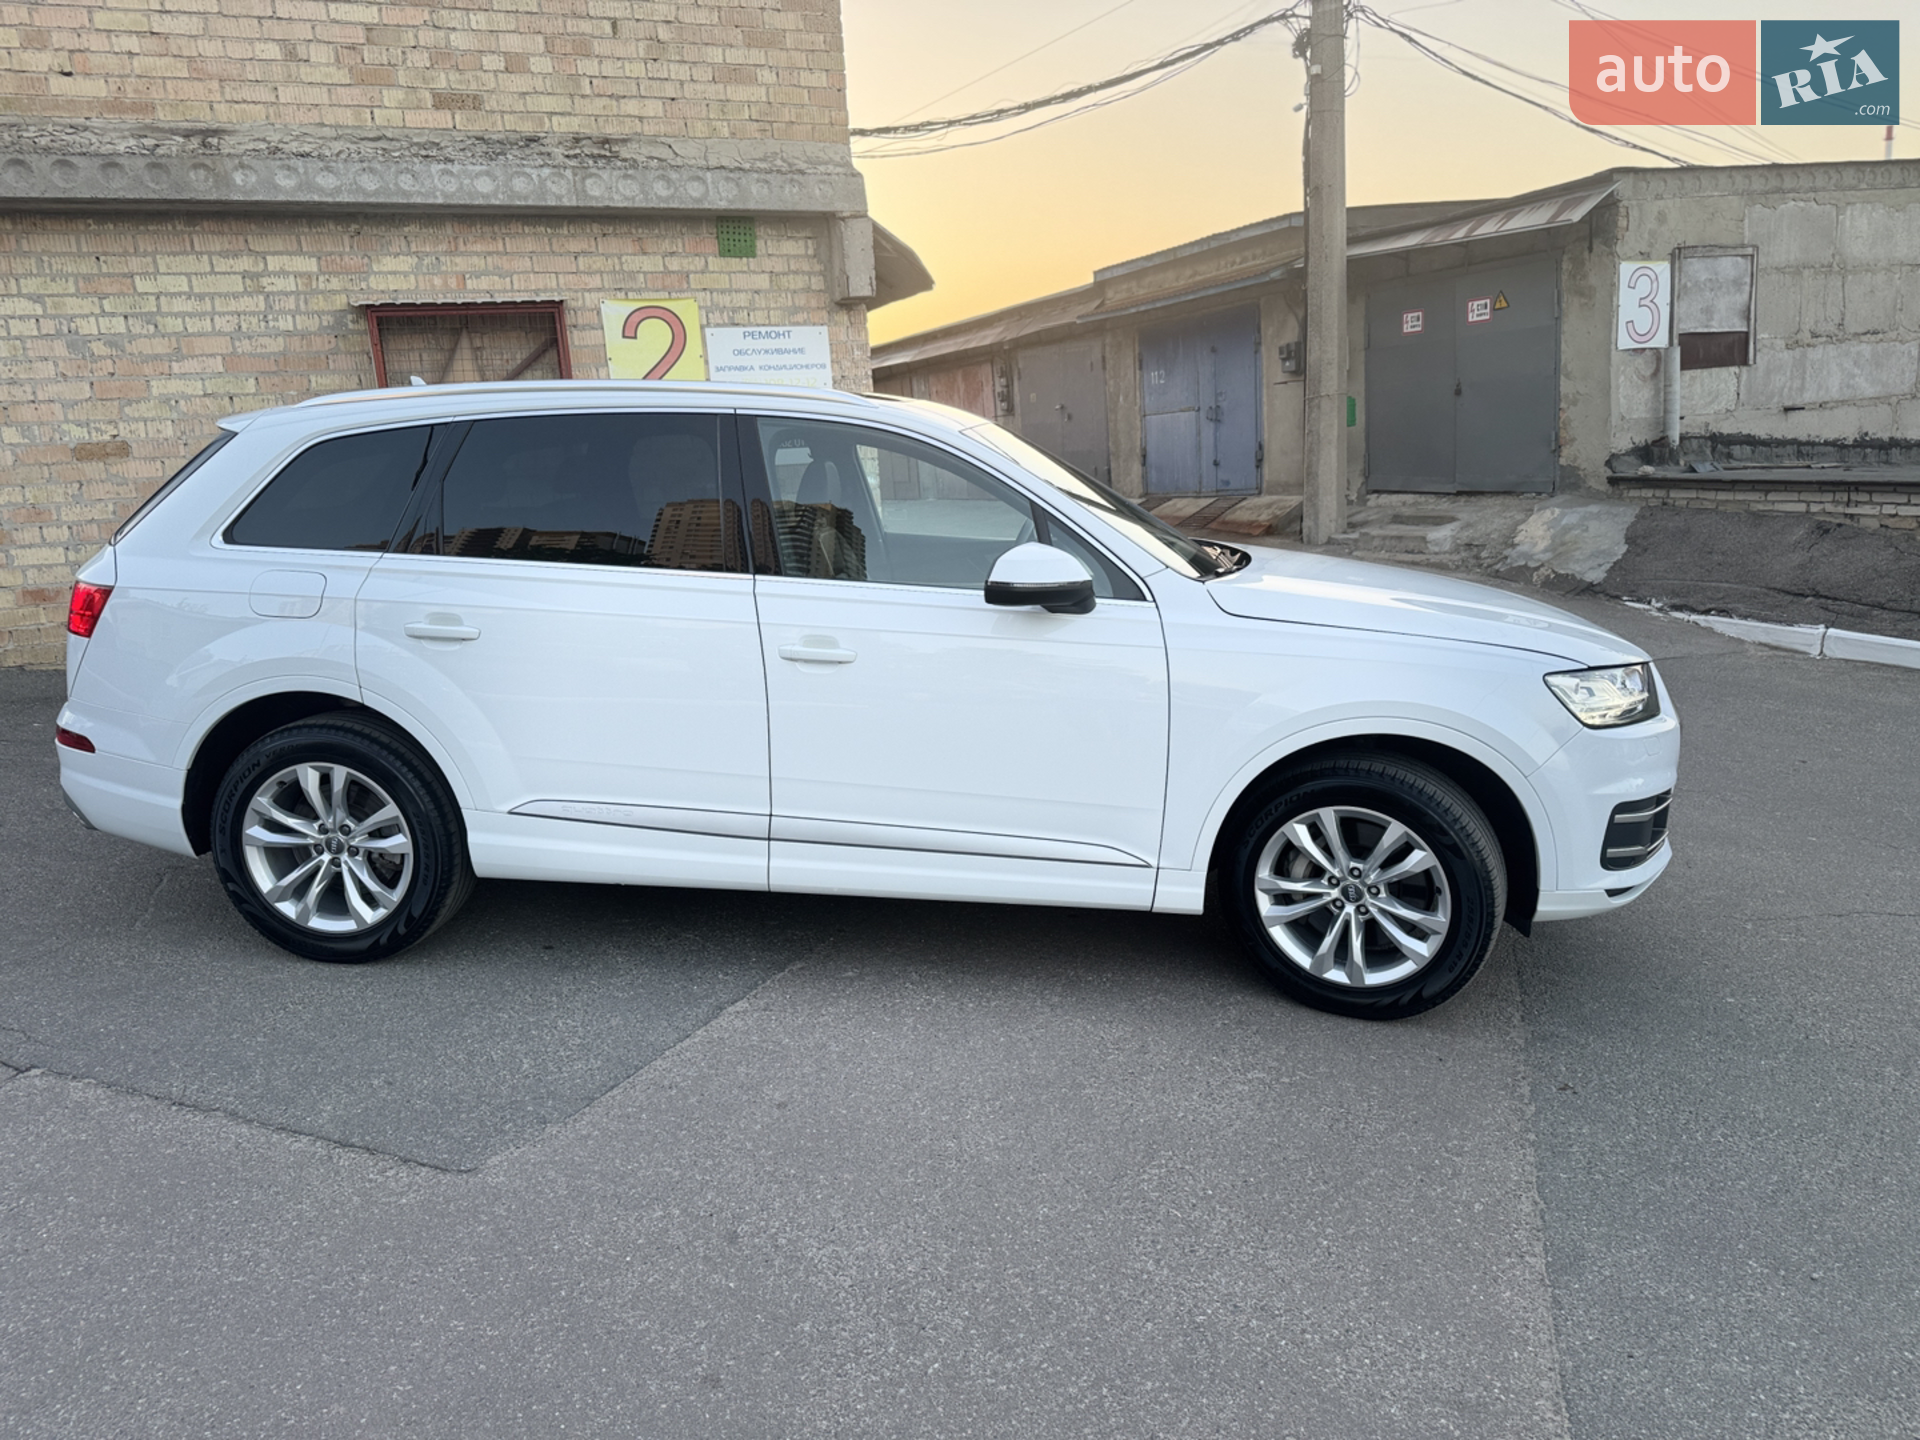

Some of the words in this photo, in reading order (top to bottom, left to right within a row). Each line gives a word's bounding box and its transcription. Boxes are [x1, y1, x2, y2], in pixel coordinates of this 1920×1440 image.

[1625, 266, 1661, 344] 3
[743, 330, 793, 340] РЕМОНТ
[622, 305, 687, 380] 2
[732, 346, 806, 357] ОБСЛУЖИВАНИЕ
[714, 364, 755, 373] ЗАПРАВКА
[758, 362, 827, 372] КОНДИЦИОНЕРОВ
[1151, 370, 1166, 384] 112
